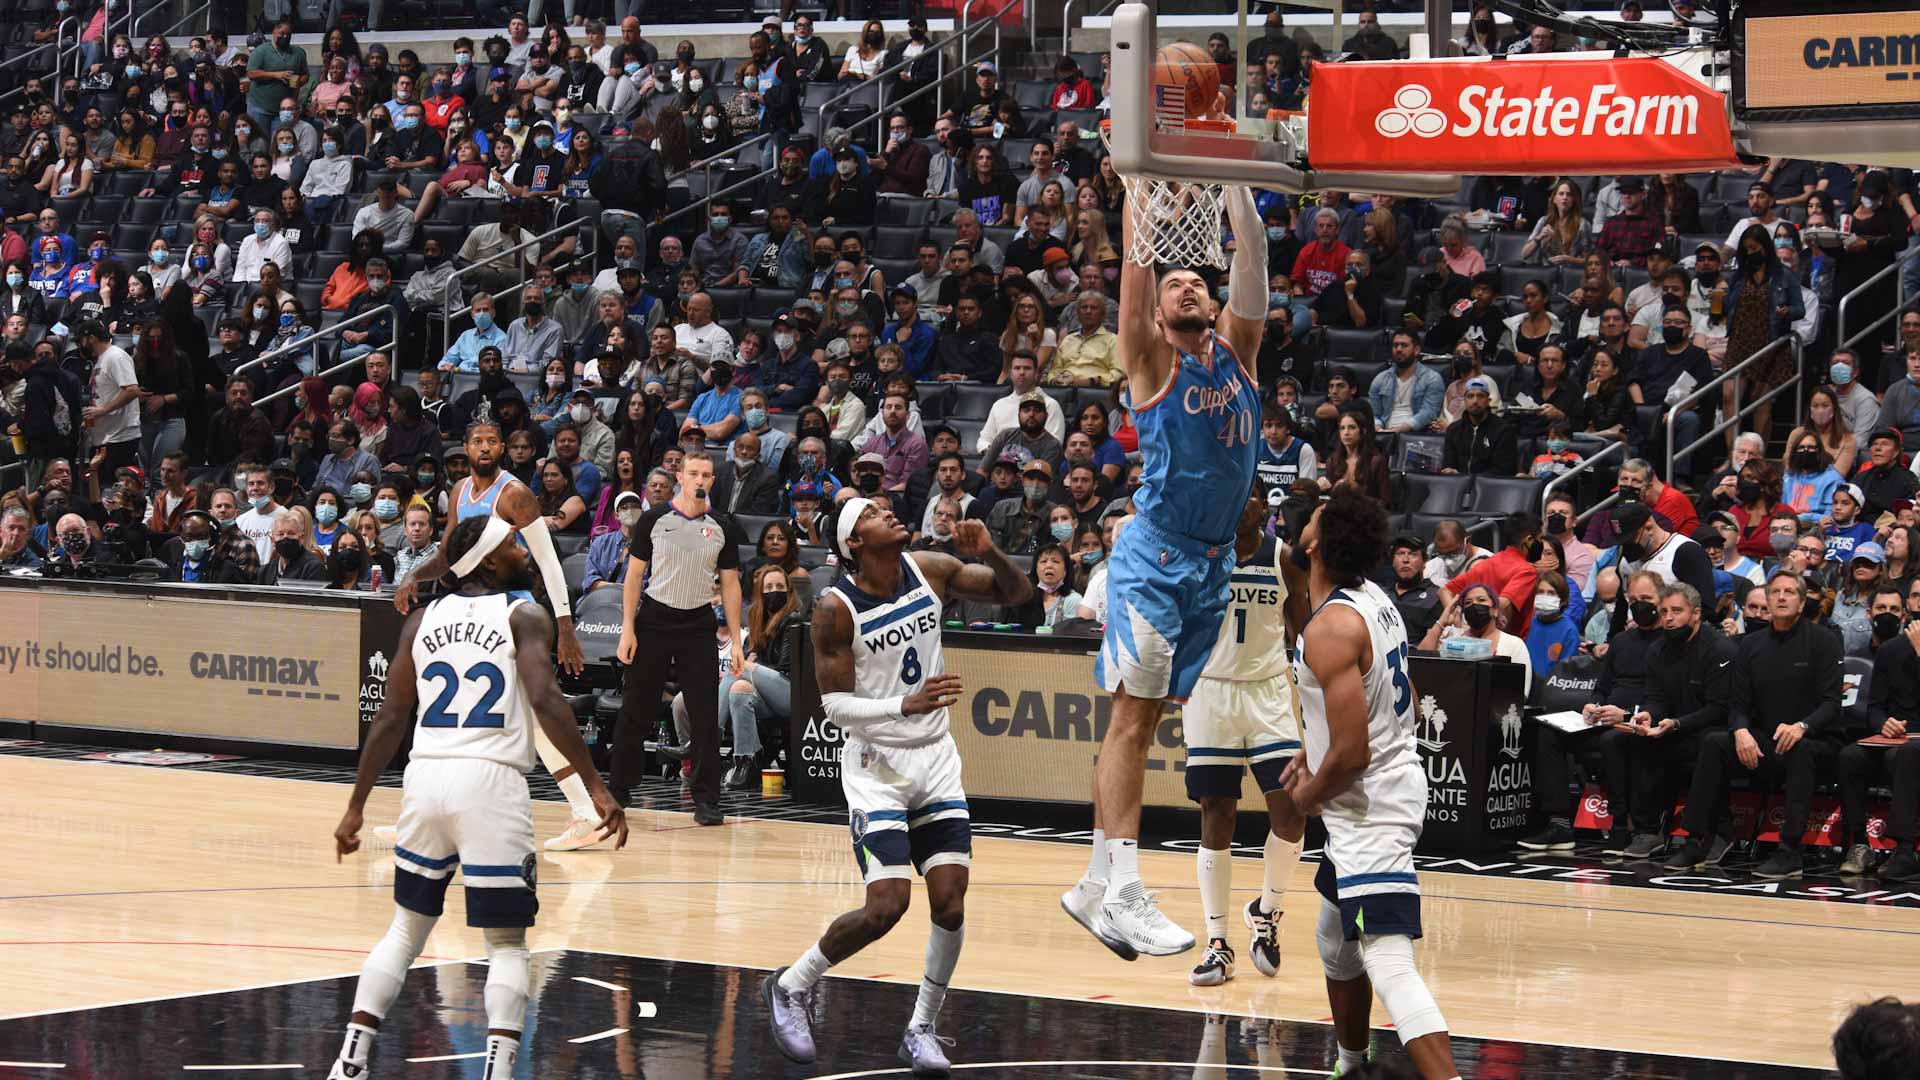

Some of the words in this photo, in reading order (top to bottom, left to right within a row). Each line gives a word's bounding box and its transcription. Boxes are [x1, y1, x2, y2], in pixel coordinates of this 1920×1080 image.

[1217, 409, 1253, 448] 40
[422, 622, 507, 654] BEVERLEY
[865, 612, 937, 654] WOLVES
[1235, 609, 1247, 643] 1
[26, 640, 40, 667] it
[45, 641, 121, 674] should
[127, 646, 164, 677] be.
[190, 651, 320, 686] CARmax
[901, 647, 922, 686] 8
[421, 661, 505, 728] 22
[808, 765, 840, 779] CASI
[1427, 755, 1467, 785] UA
[1488, 763, 1531, 792] AGUA
[1487, 793, 1531, 814] CALIENTE
[1490, 814, 1527, 830] CASINOS
